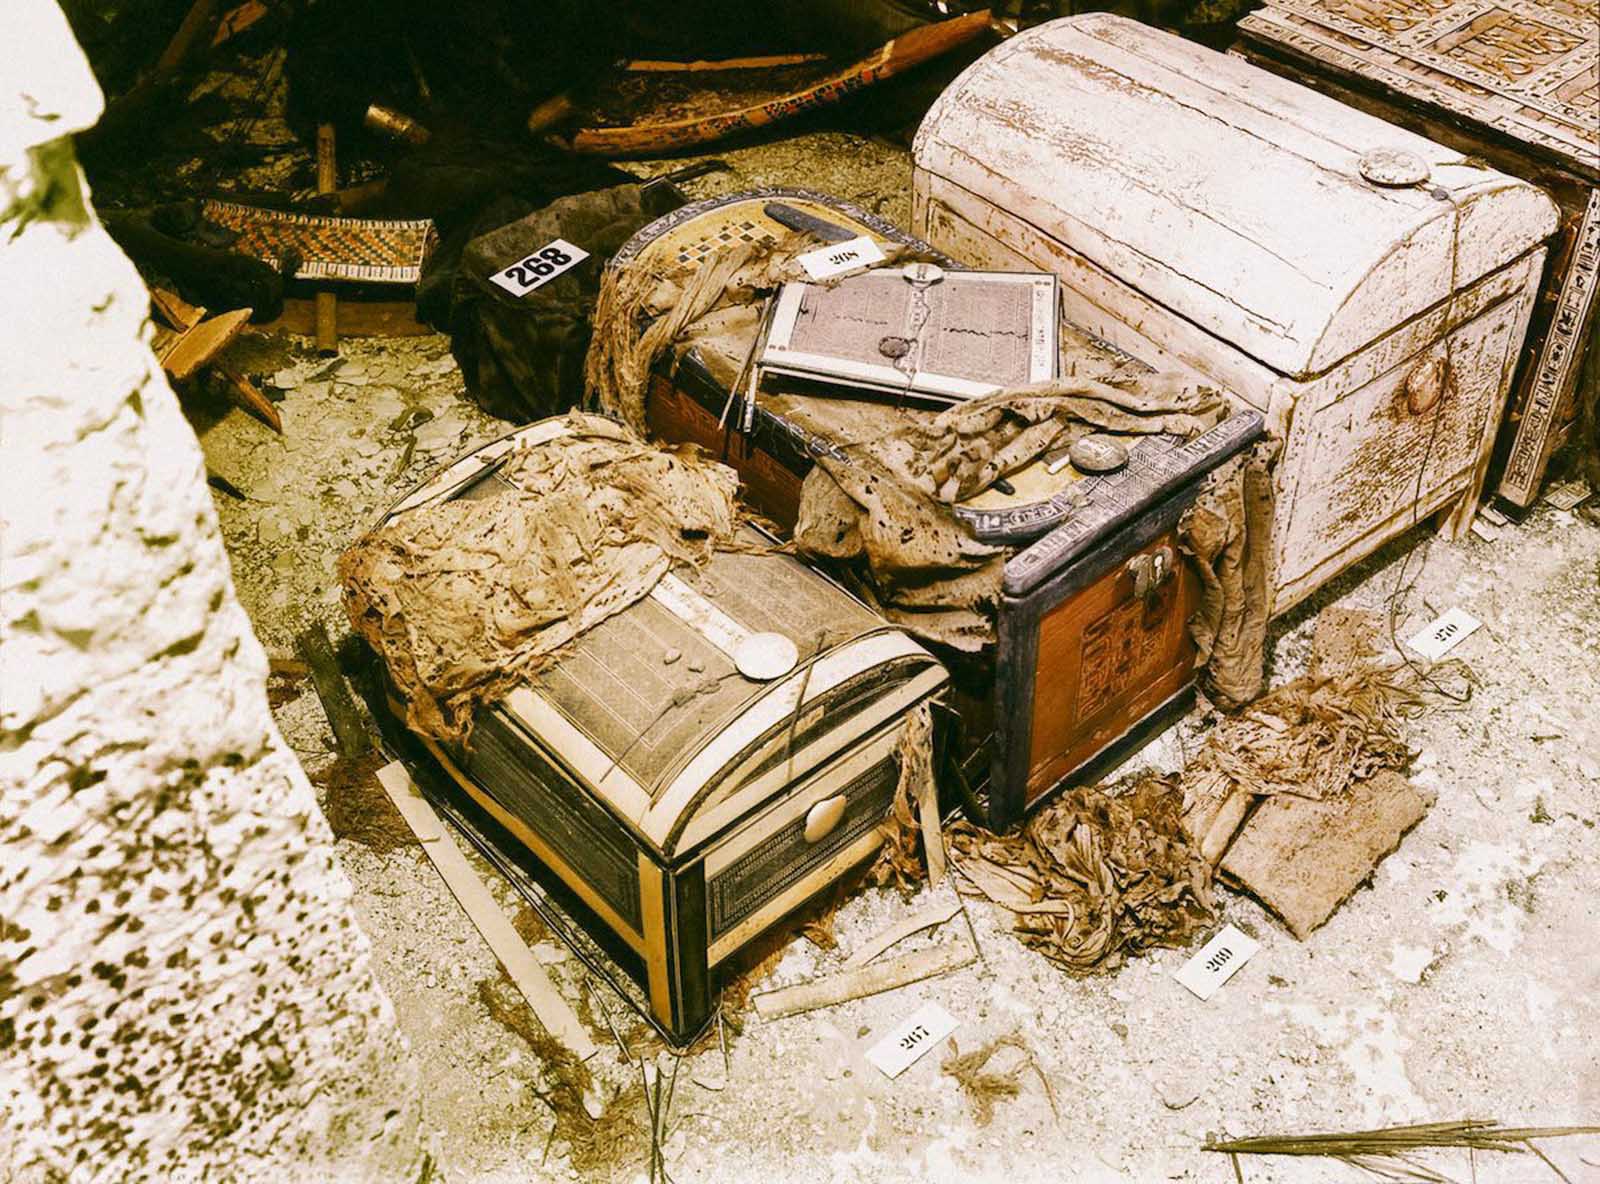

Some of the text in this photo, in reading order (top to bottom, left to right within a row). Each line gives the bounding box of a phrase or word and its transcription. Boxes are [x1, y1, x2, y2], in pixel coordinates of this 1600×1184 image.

[505, 248, 572, 287] 268
[1434, 623, 1458, 642] 270
[1205, 947, 1233, 973] 269
[900, 1025, 930, 1050] 267
